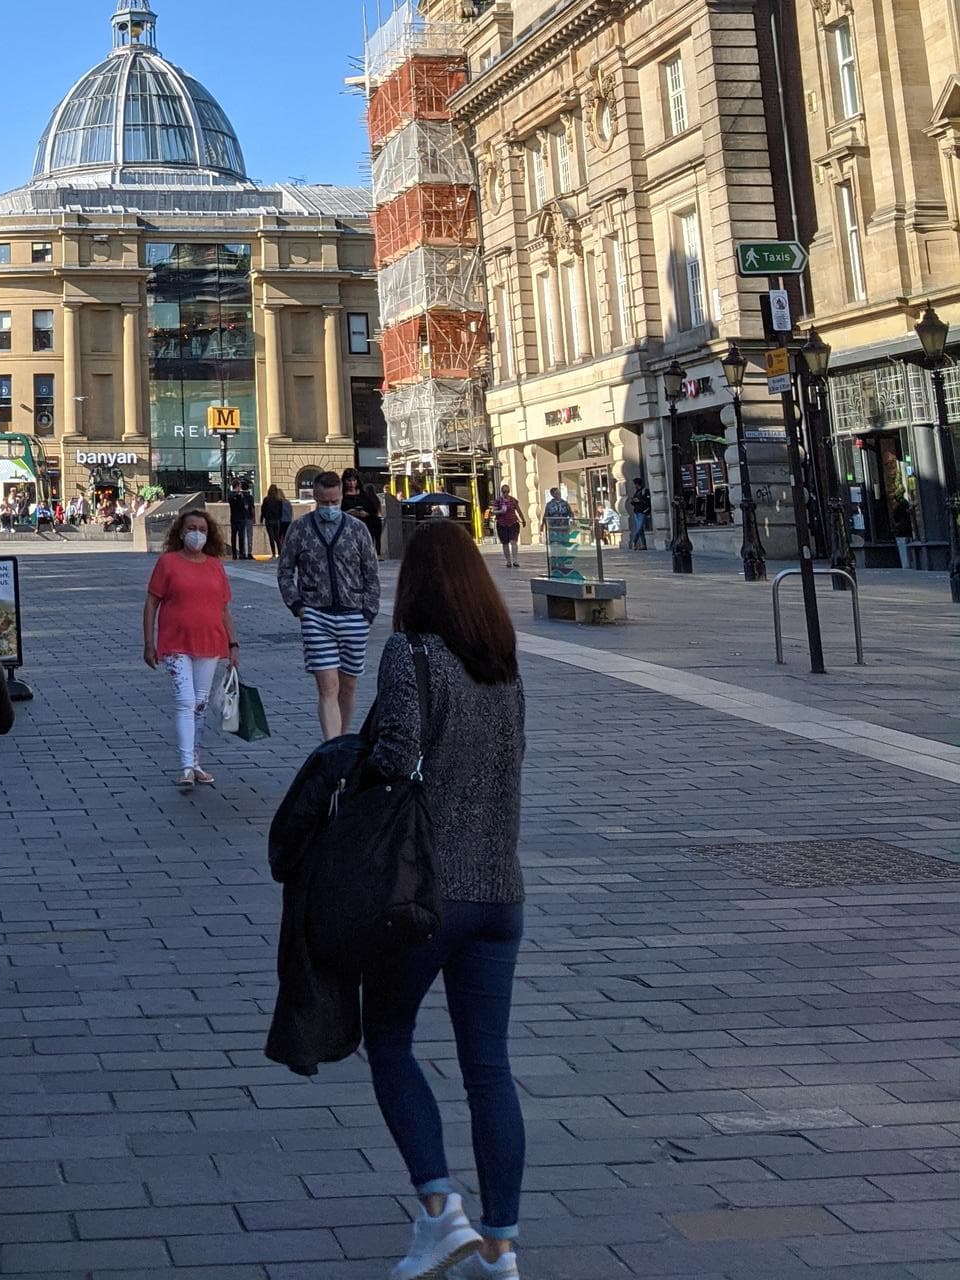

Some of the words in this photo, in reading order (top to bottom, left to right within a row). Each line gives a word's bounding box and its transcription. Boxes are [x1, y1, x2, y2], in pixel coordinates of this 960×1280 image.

[762, 252, 790, 262] Taxis
[216, 410, 235, 426] M
[76, 450, 137, 468] banyan
